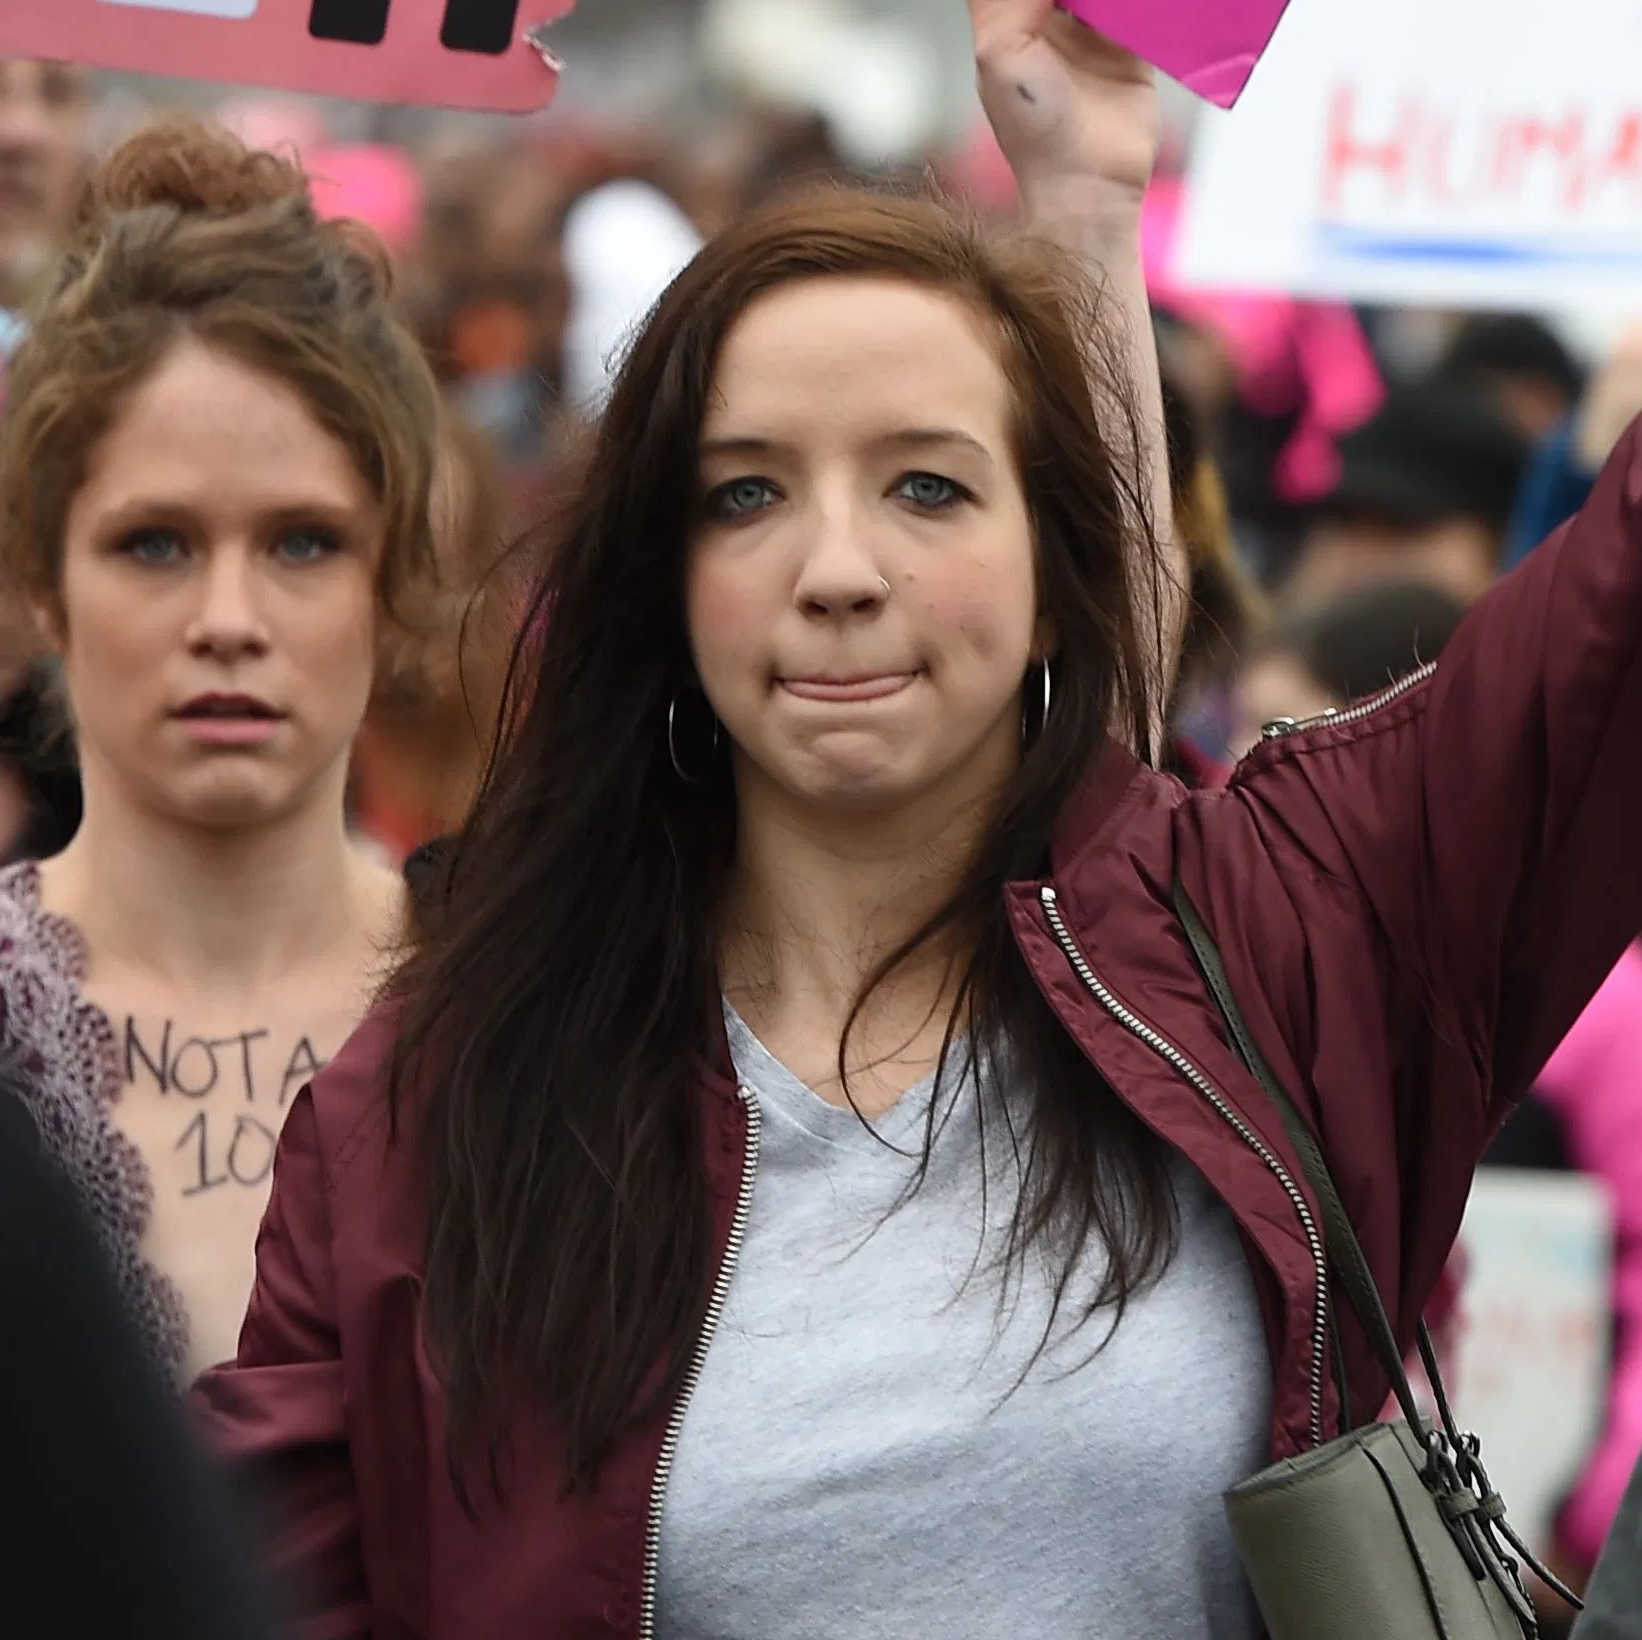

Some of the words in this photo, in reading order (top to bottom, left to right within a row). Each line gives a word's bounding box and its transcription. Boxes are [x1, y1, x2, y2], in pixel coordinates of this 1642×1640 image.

[124, 1013, 269, 1102] NOT
[278, 1035, 327, 1106] A
[174, 1111, 275, 1198] 10
